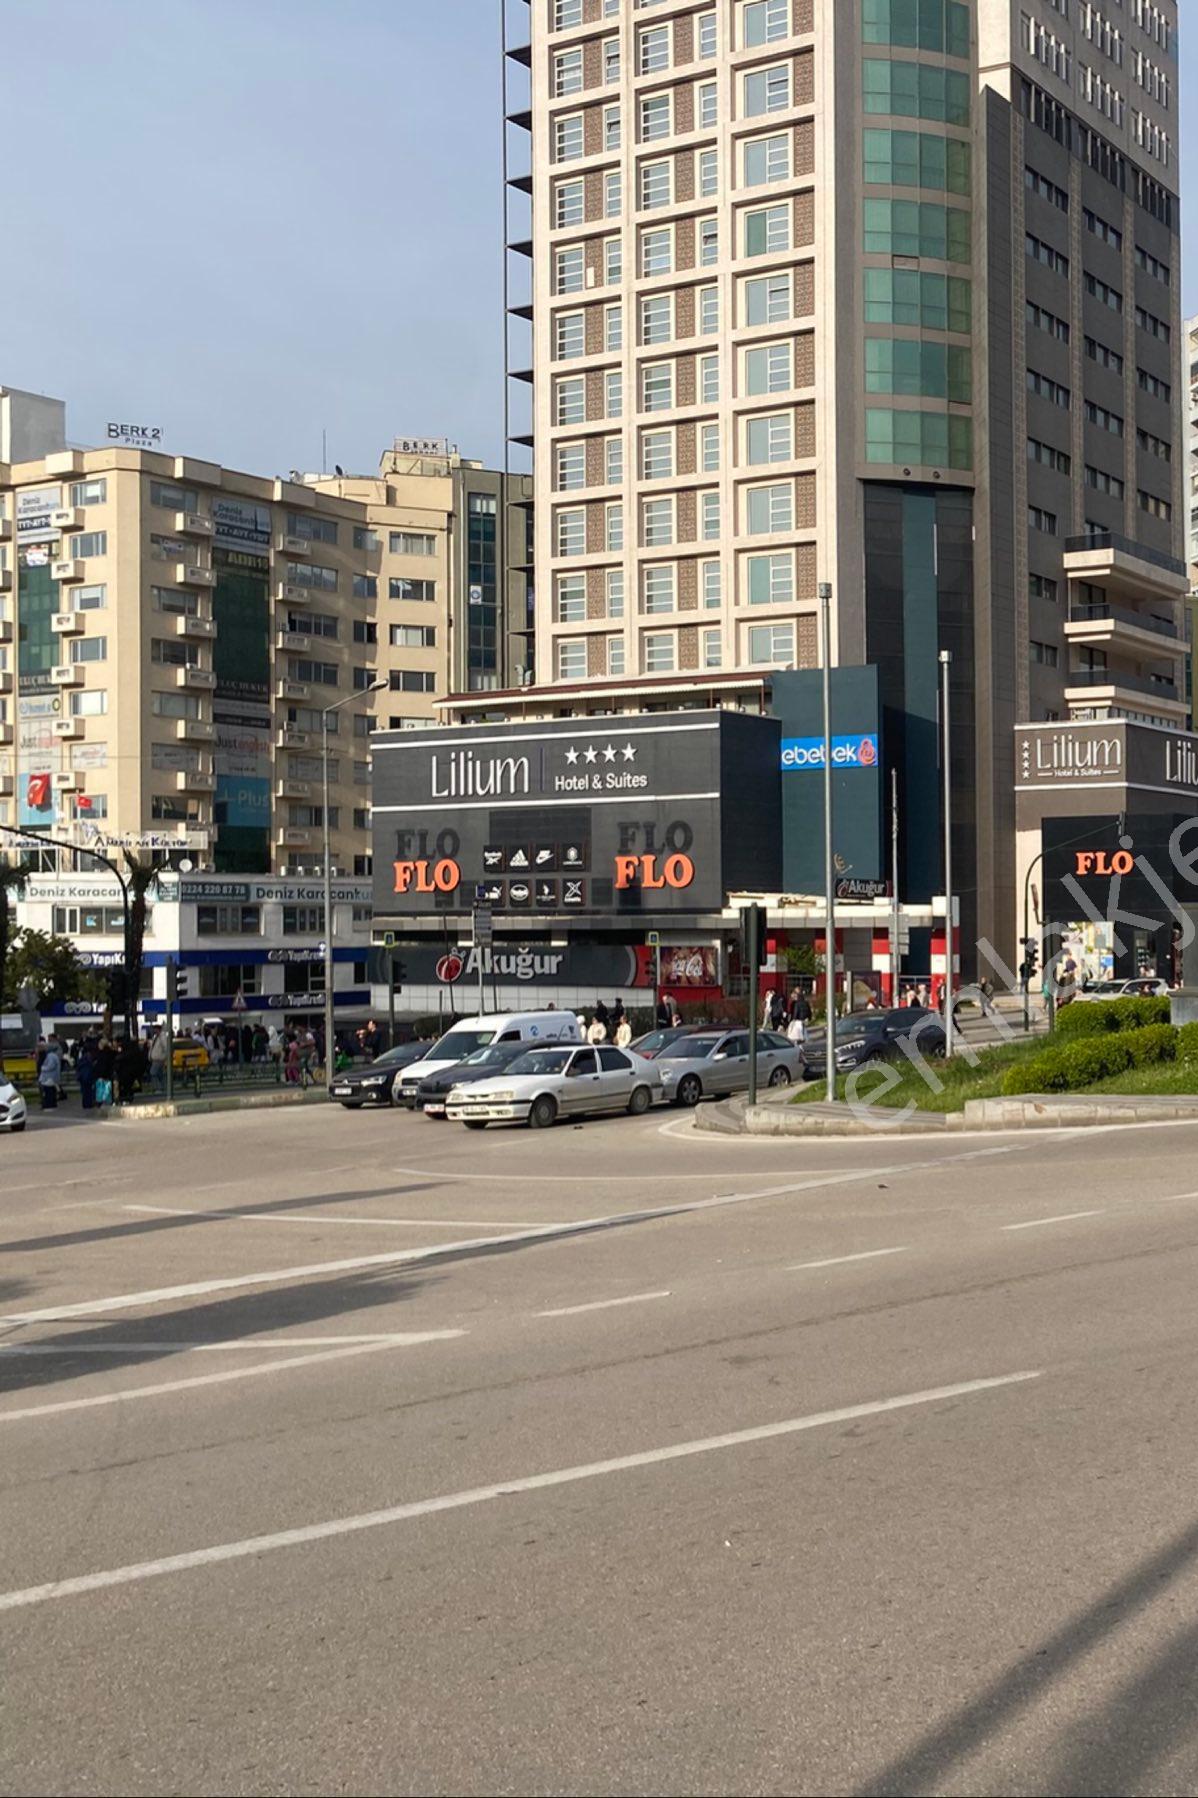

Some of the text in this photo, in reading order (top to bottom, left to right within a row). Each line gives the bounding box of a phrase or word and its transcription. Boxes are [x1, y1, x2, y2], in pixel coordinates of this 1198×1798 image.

[107, 422, 161, 439] BERK 2
[1036, 734, 1121, 769] Lilium
[432, 750, 530, 798] Lilium
[555, 771, 648, 792] Hotel & Suites
[1054, 769, 1073, 777] Hotel
[1080, 768, 1102, 777] Suites
[615, 852, 695, 889] FLO
[1076, 851, 1134, 875] FLO
[393, 858, 461, 892] FLO
[30, 885, 66, 897] Deniz
[256, 885, 294, 899] Deniz
[849, 879, 885, 897] Akuğur
[466, 947, 563, 979] Akuğur
